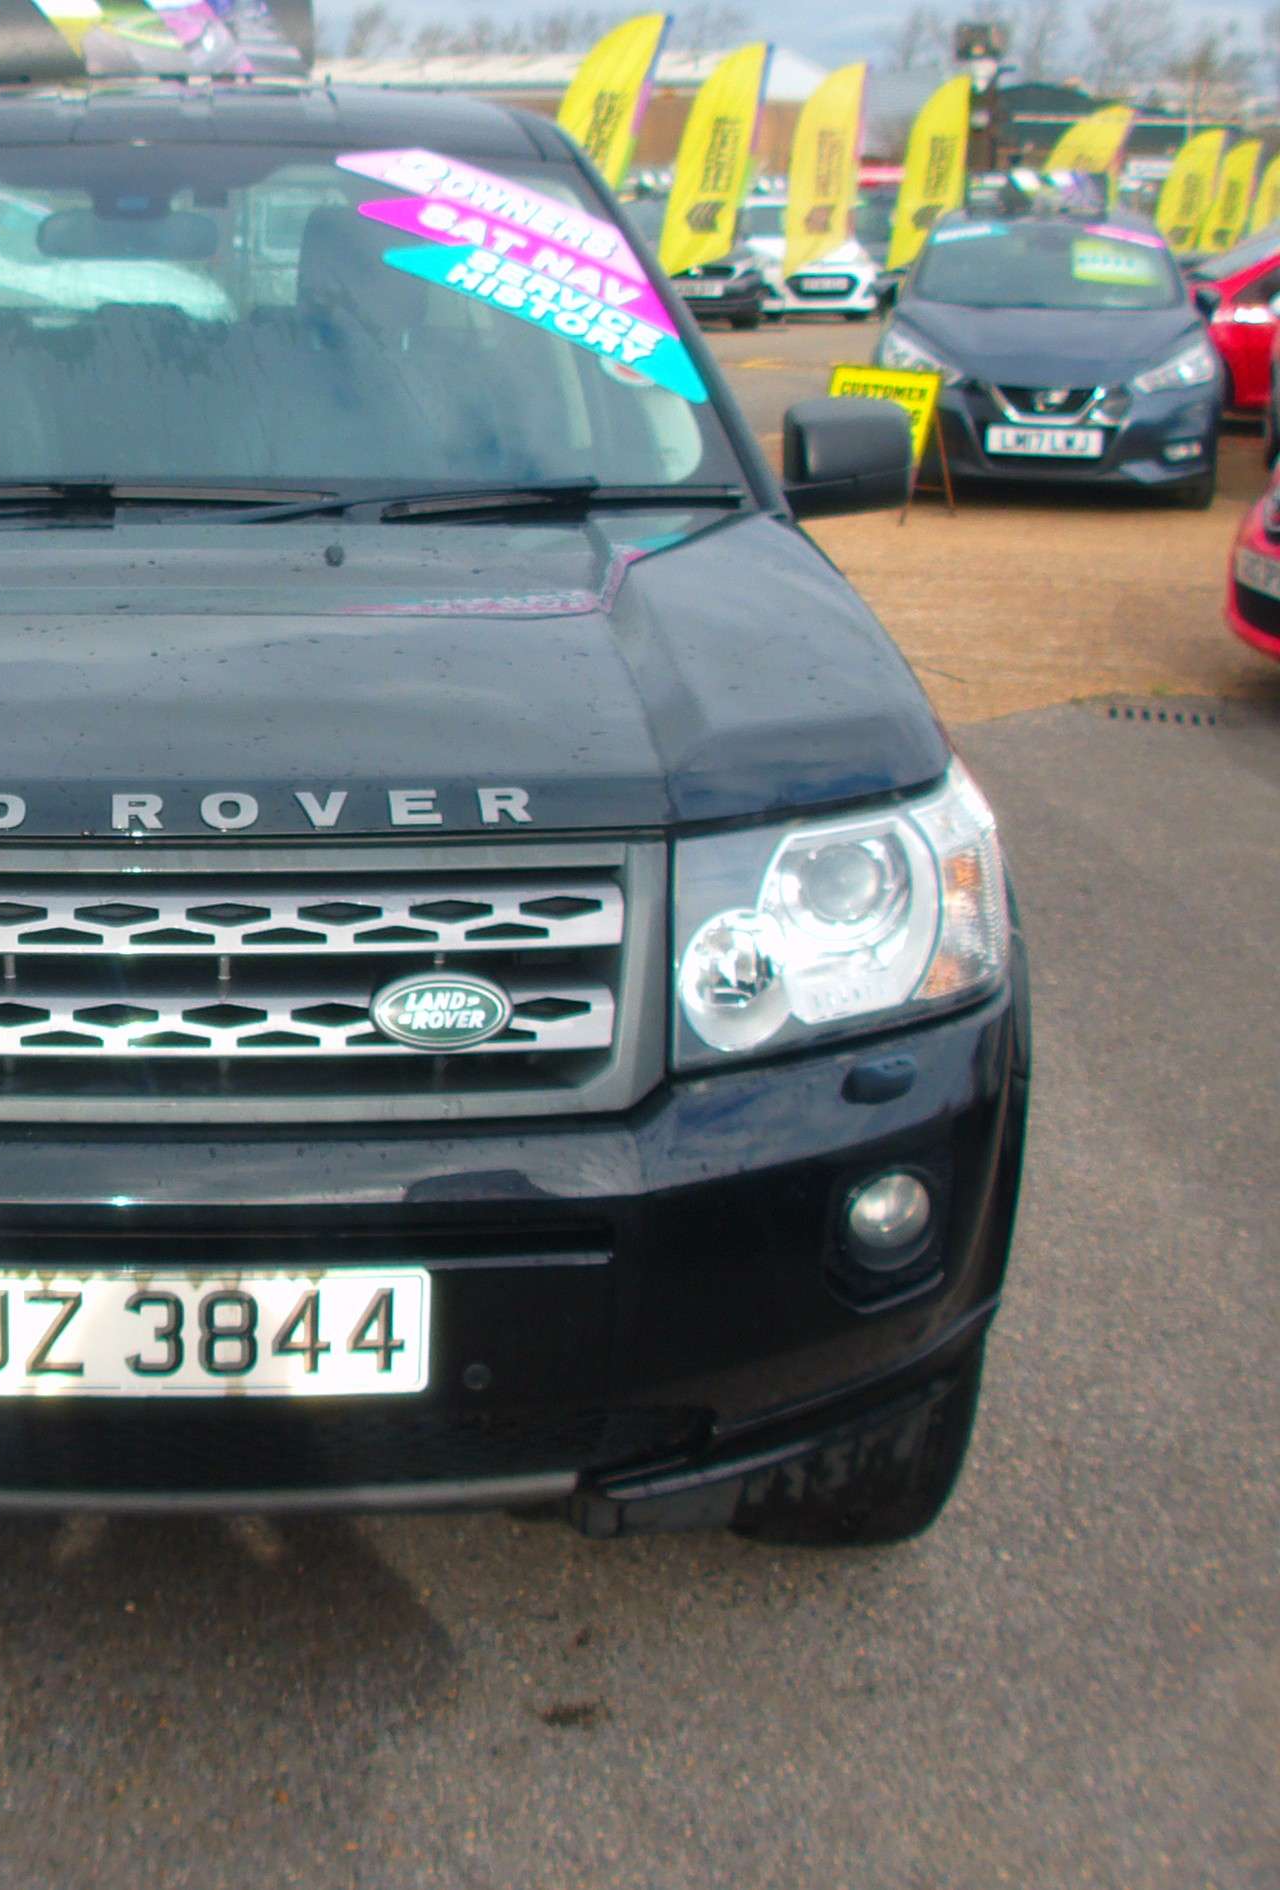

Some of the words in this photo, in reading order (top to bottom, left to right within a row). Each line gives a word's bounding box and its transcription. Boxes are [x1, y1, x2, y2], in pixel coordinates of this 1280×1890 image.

[417, 203, 528, 260] SAT
[531, 248, 643, 306] NAV
[440, 172, 618, 259] OWNERS
[444, 263, 654, 364] HISTORY
[466, 250, 666, 352] SERVICE
[840, 382, 929, 402] CUSTOMER
[111, 787, 534, 830] ROVER
[405, 991, 467, 1012] LAND
[411, 1010, 487, 1031] ROVER
[123, 1287, 406, 1378] 3844
